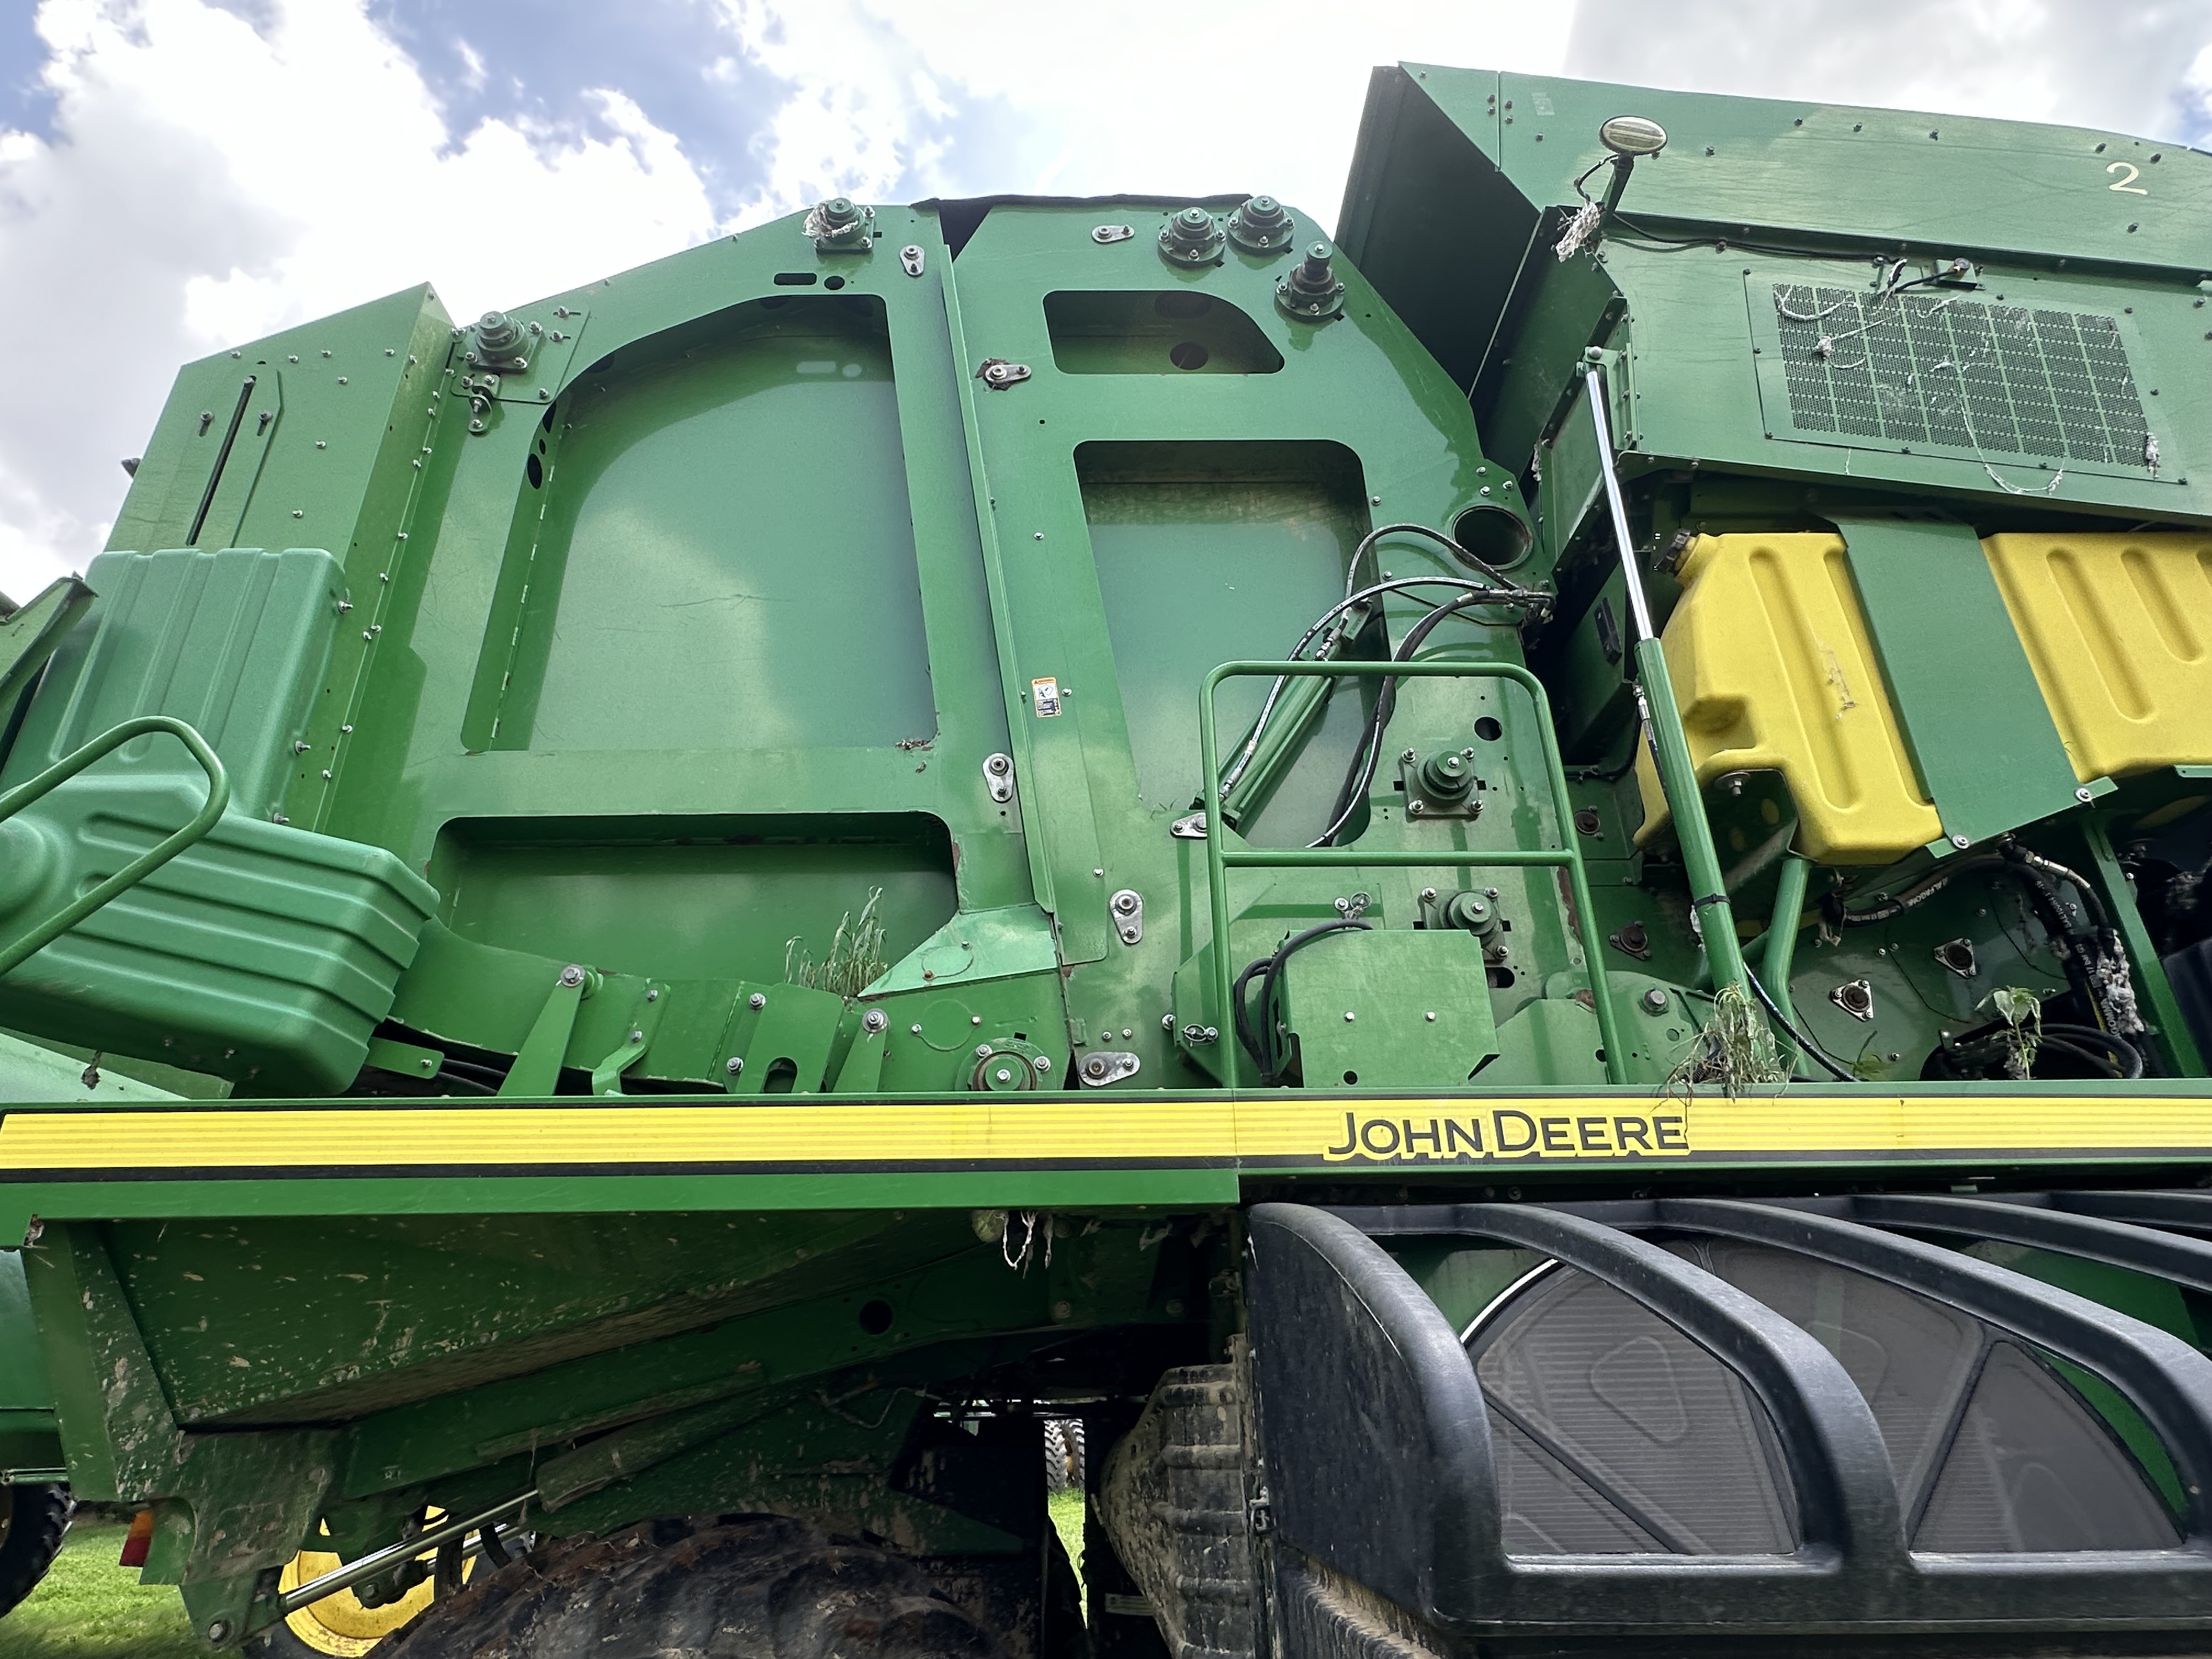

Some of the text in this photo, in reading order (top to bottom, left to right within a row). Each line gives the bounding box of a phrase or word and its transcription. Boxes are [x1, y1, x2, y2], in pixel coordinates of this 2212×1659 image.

[2106, 162, 2148, 195] 2
[1328, 1110, 1688, 1154] JOHN DEERE
